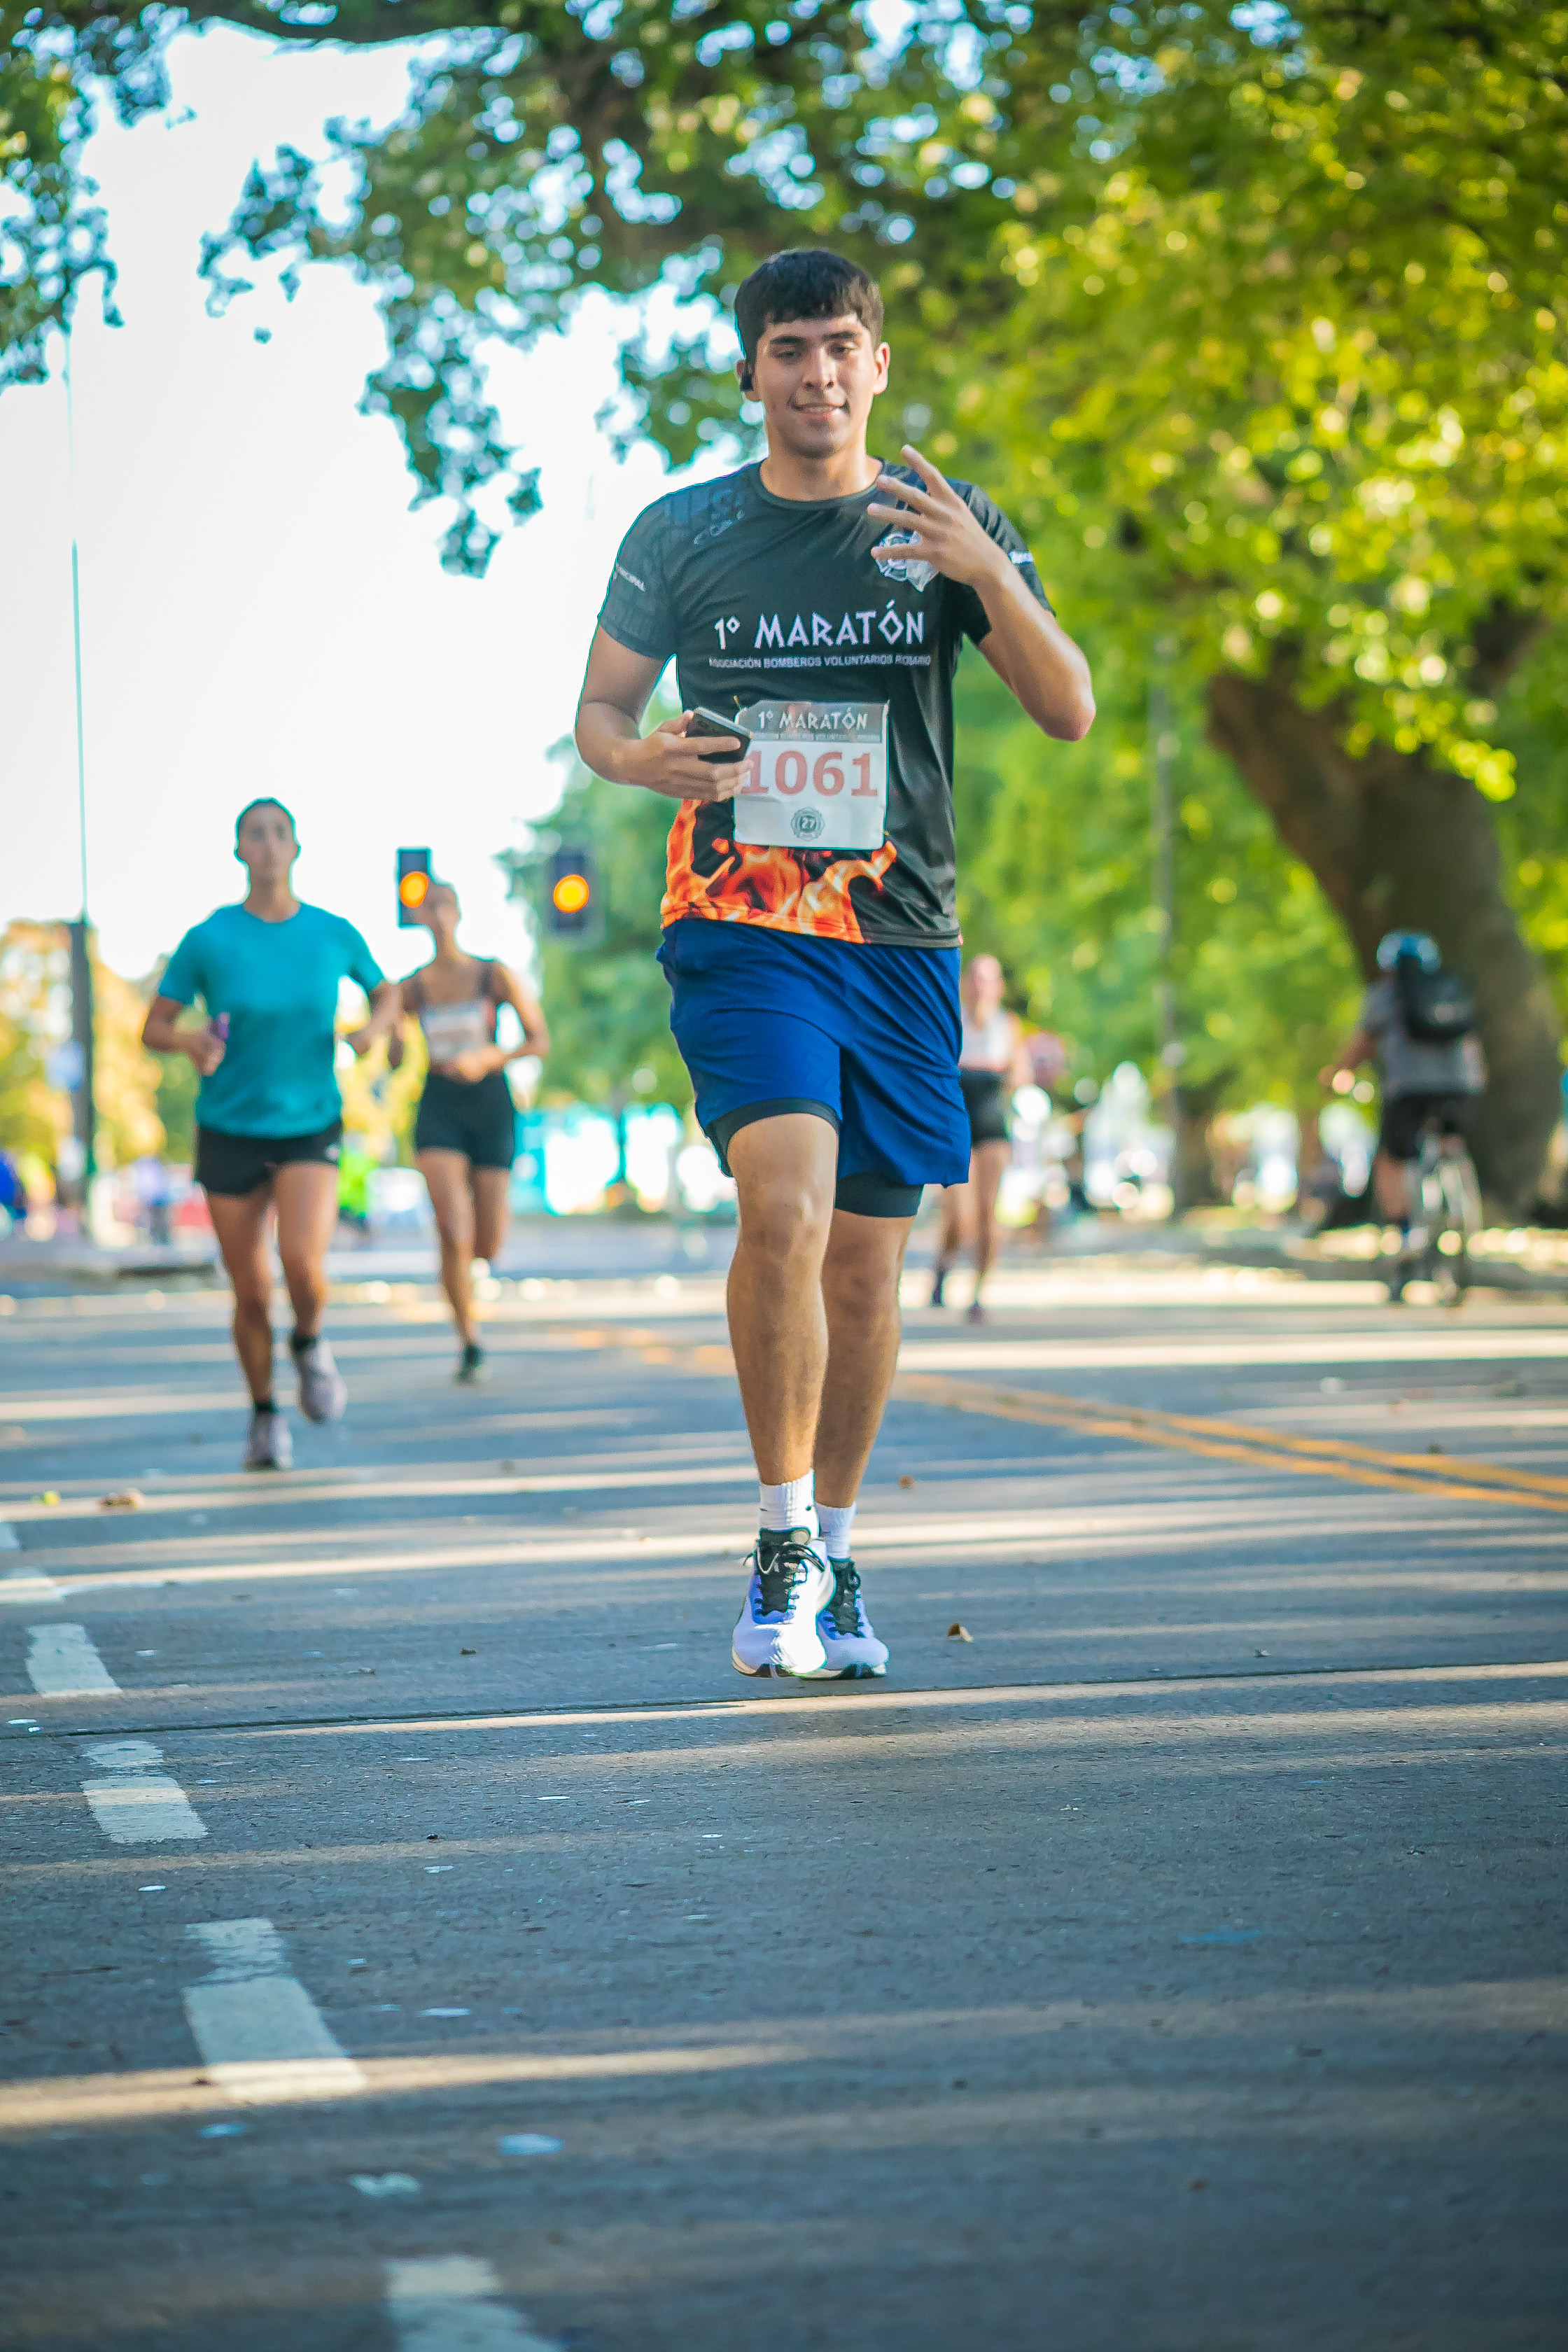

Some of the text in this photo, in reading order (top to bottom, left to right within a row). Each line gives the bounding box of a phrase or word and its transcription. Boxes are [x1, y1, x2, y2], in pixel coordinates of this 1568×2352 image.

[754, 598, 925, 649] MARATÓN
[763, 656, 822, 668] BOMBEROS
[824, 654, 893, 666] VOLUNTARIOS
[779, 707, 869, 730] MARATÓN
[740, 750, 878, 797] 1061
